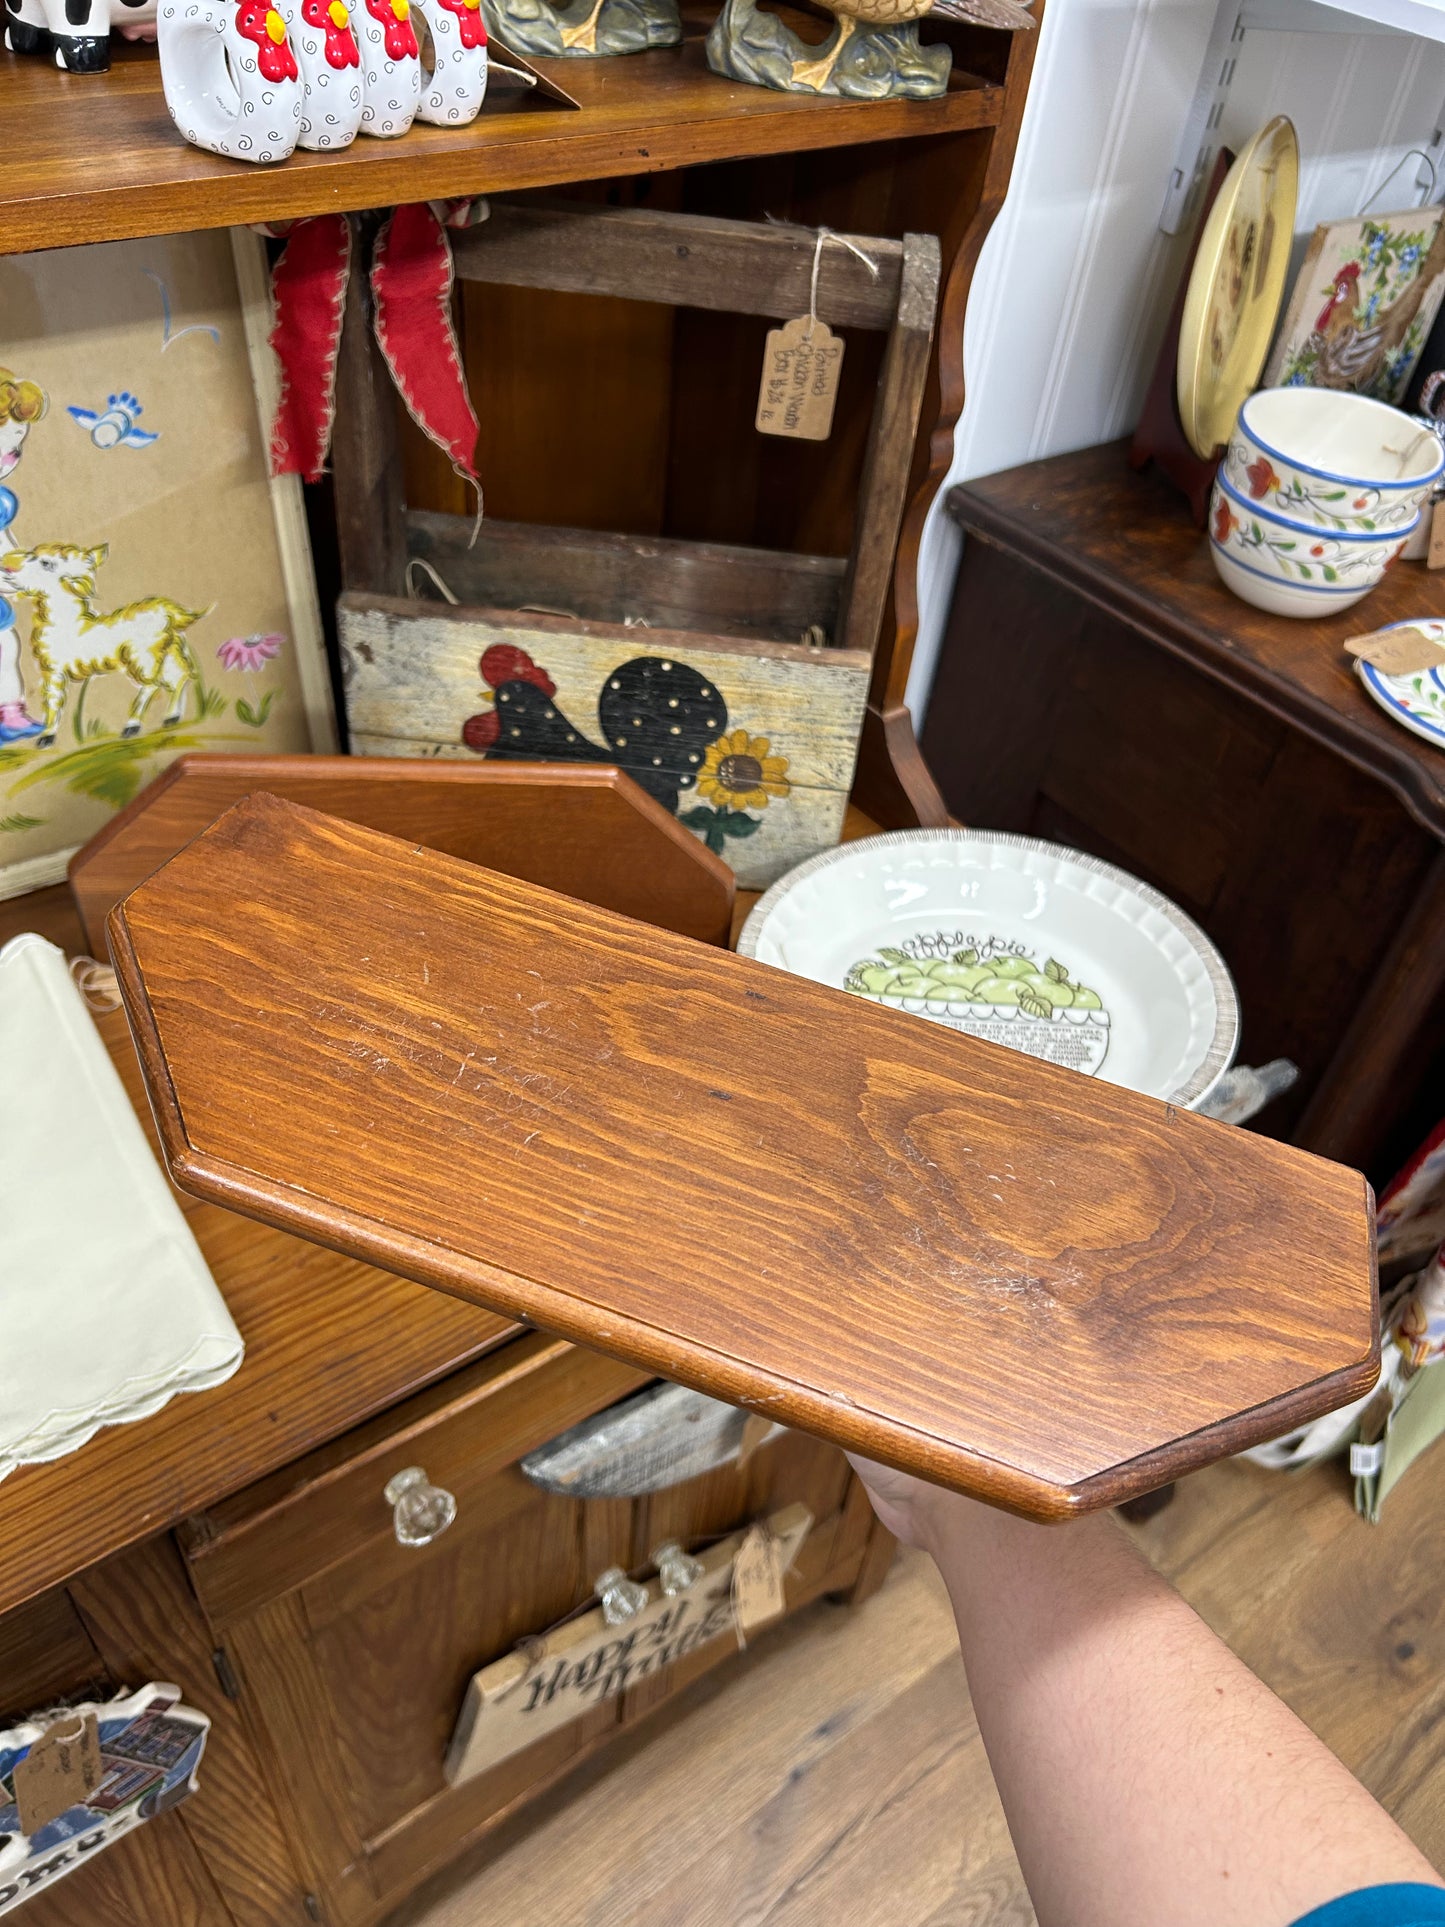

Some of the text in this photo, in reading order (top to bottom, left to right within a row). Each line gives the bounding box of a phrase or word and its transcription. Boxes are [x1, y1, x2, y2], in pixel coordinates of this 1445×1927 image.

[811, 347, 838, 396] Painted
[902, 930, 1036, 960] apple pie
